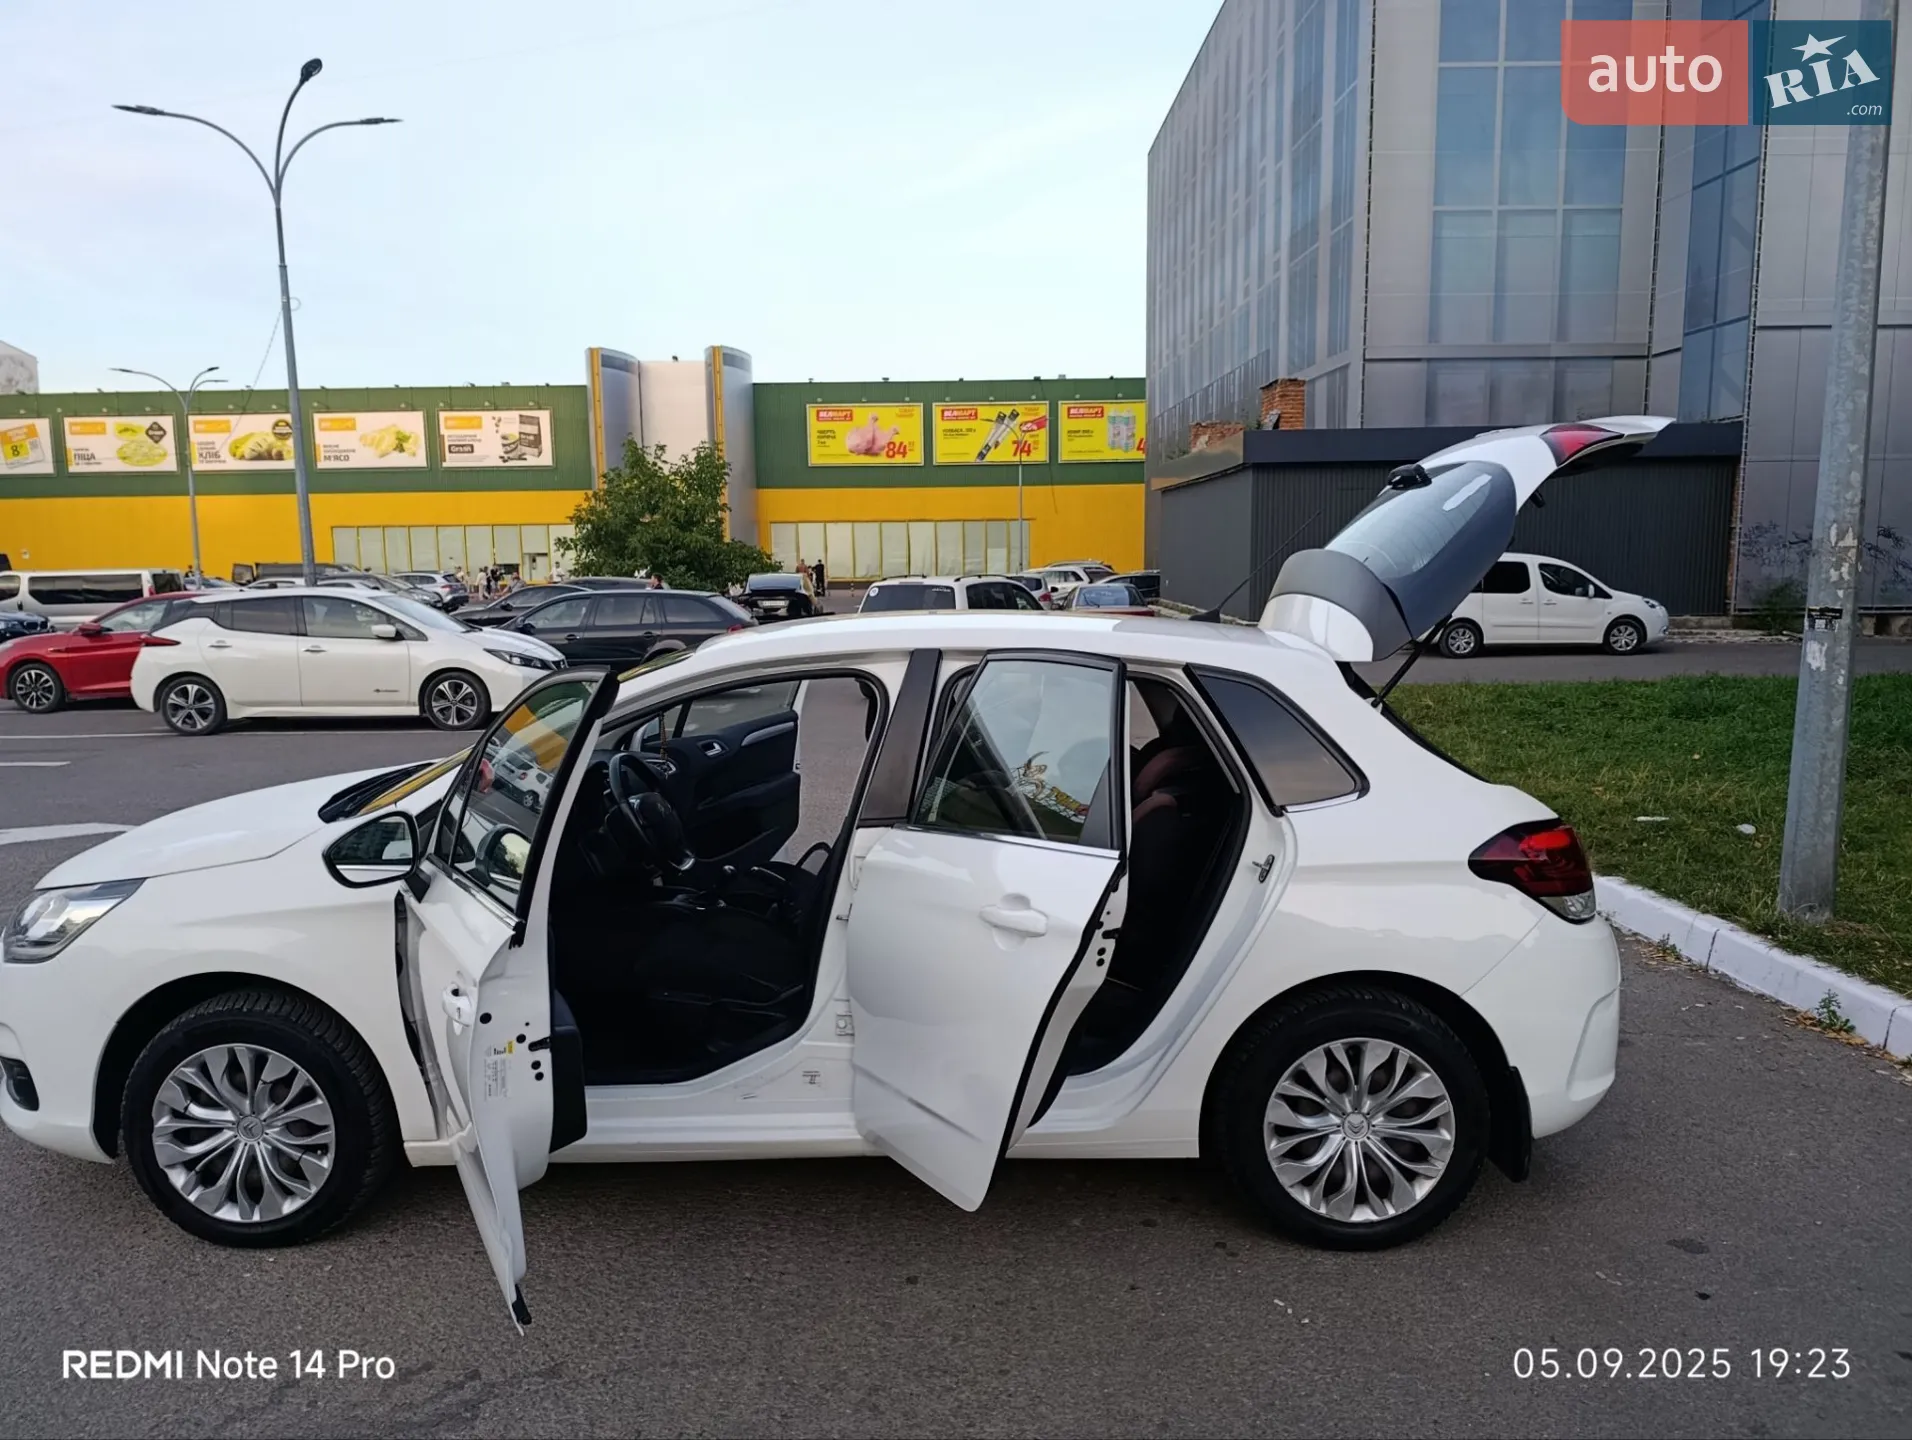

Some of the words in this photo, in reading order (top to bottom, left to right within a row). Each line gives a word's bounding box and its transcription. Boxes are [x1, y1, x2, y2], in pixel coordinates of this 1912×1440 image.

[74, 452, 96, 461] ПІЦА
[886, 441, 908, 459] 84
[1012, 440, 1032, 457] 74
